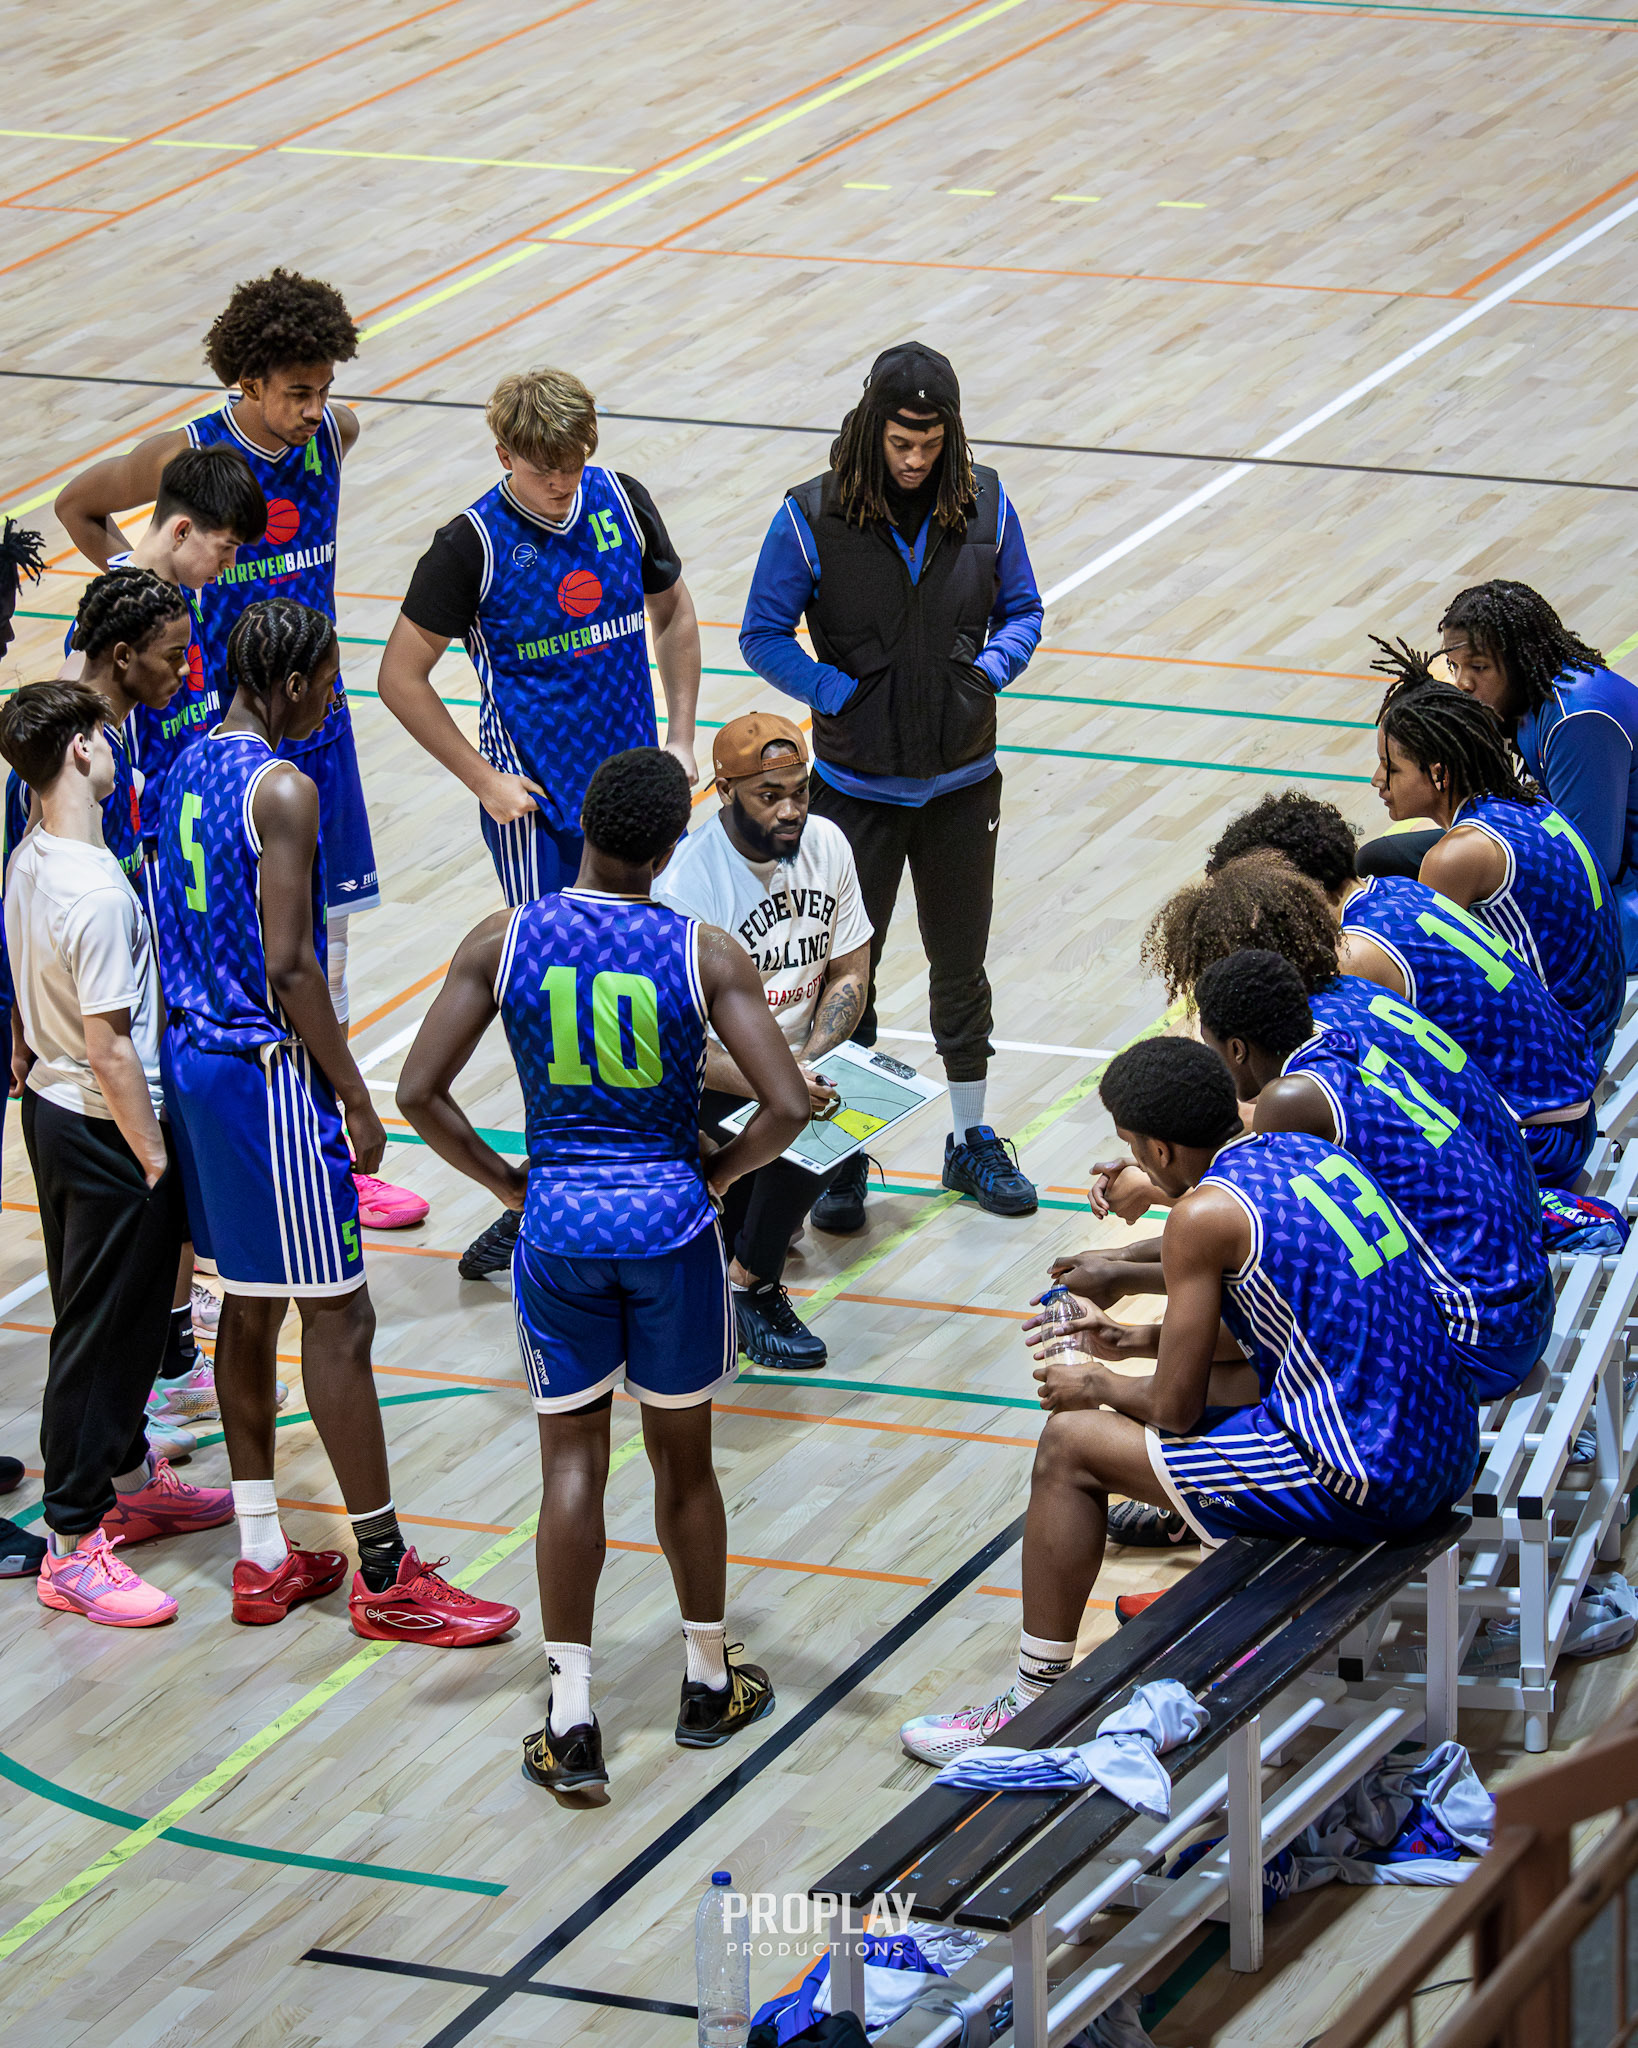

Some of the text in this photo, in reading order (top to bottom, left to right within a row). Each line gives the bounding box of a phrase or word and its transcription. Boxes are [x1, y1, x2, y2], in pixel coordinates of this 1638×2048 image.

[305, 436, 322, 476] 4
[588, 508, 622, 553] 15
[516, 610, 644, 660] FOREVERBALLING
[179, 791, 207, 912] 5
[738, 888, 837, 950] FOREVER
[767, 986, 804, 1007] DAYS
[539, 965, 664, 1089] 10
[1367, 994, 1468, 1074] 8
[341, 1218, 359, 1263] 5
[1288, 1153, 1409, 1280] 13
